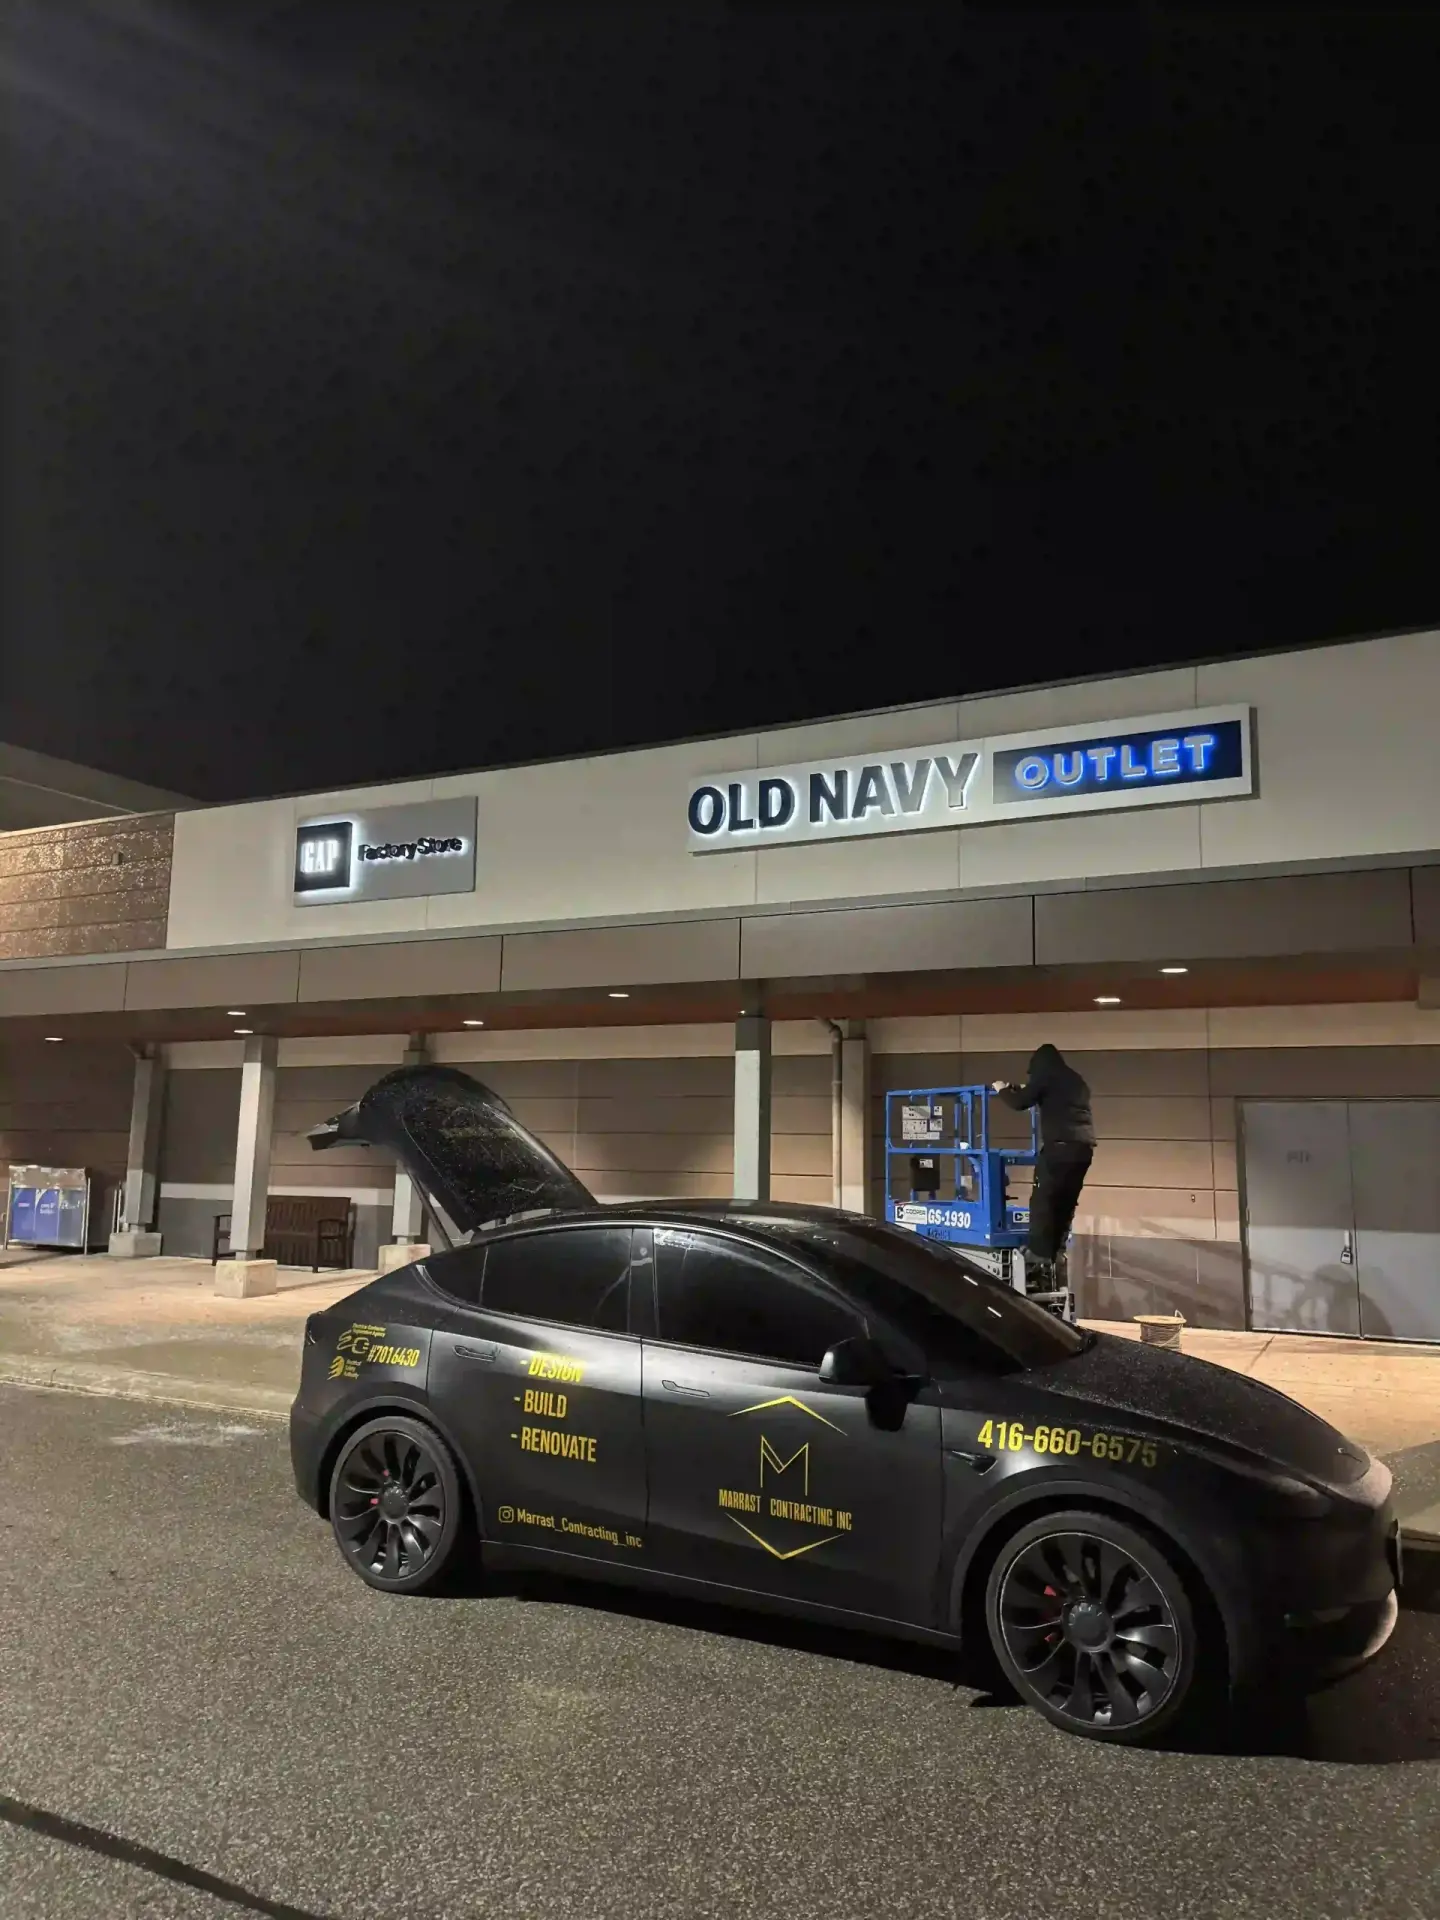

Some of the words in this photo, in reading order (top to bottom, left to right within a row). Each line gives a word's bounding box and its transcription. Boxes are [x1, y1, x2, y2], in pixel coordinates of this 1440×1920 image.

[688, 778, 796, 835] OLD
[809, 752, 979, 823] NAVY
[1015, 735, 1215, 789] OUTLET
[301, 840, 340, 873] GAP
[358, 843, 417, 862] Factory
[417, 837, 463, 855] Store
[928, 1208, 971, 1229] GS-1930
[978, 1420, 1158, 1468] 416-660-6575
[517, 1507, 643, 1547] Marrast_Contracting_inc
[718, 1488, 761, 1514] MARRAST
[770, 1498, 833, 1527] CONTRACTING
[836, 1510, 852, 1531] INC
